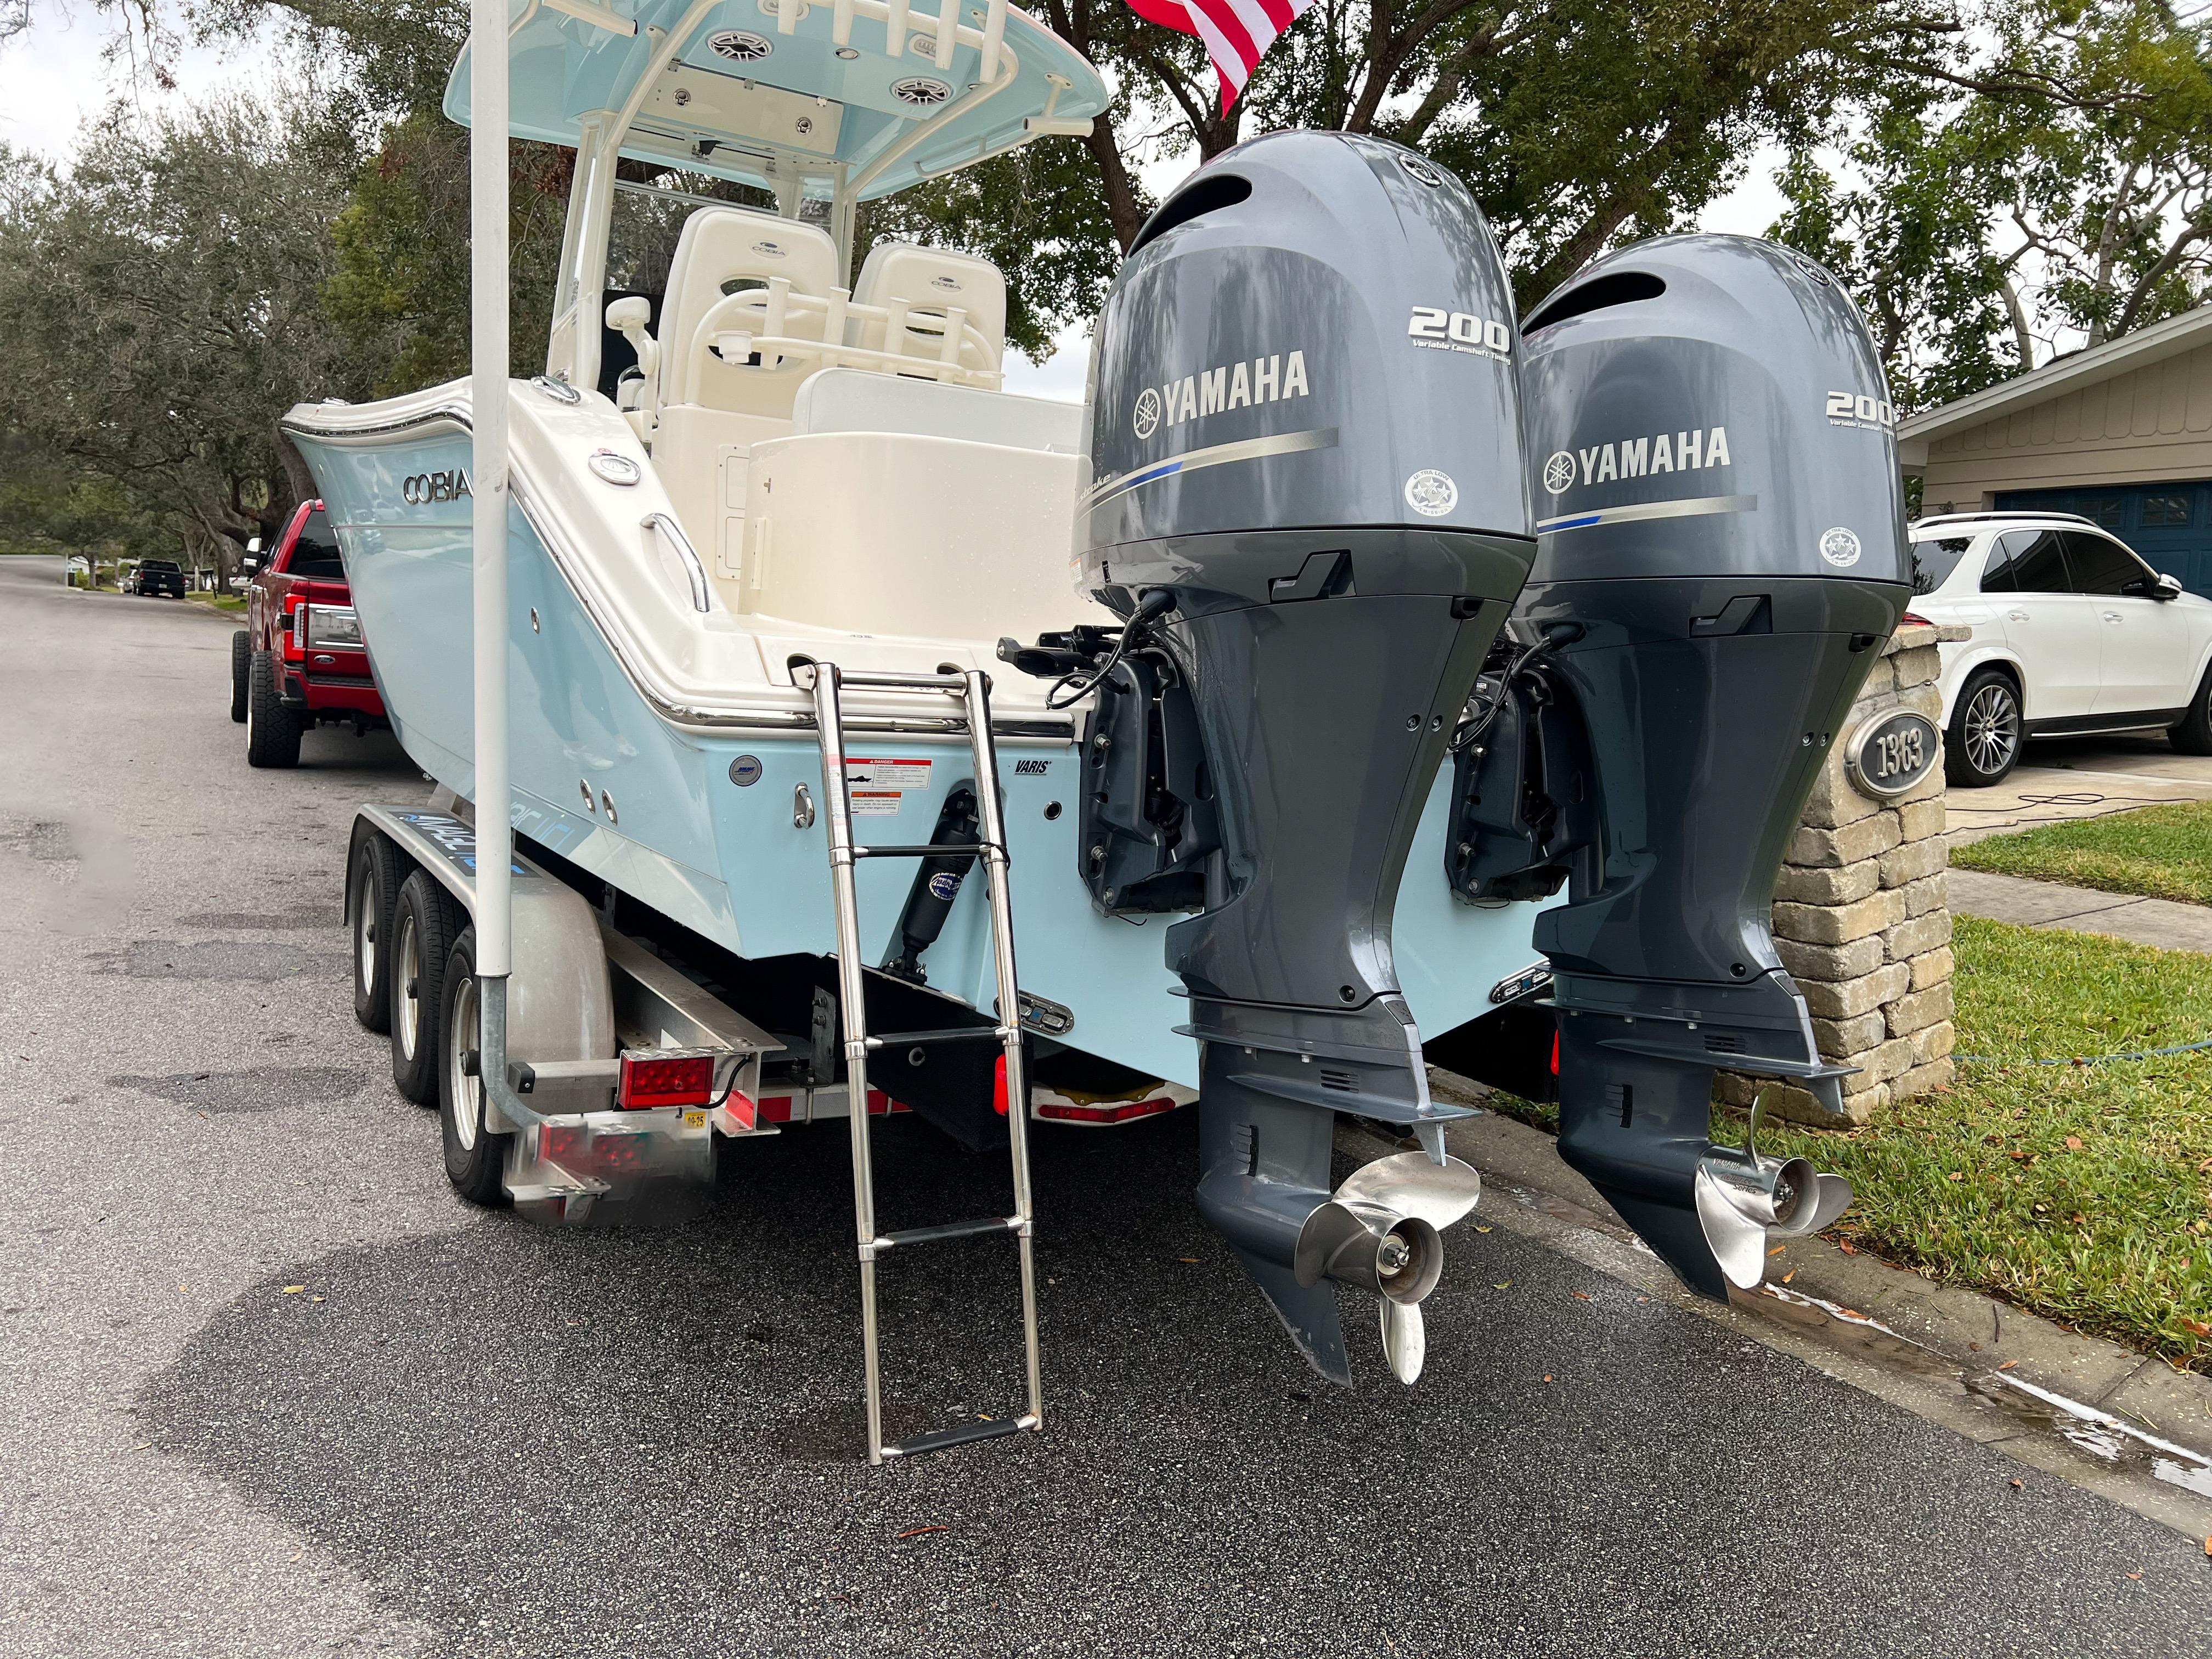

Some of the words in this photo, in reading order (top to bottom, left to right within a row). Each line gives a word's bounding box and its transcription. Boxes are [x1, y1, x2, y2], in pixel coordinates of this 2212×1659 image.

[752, 246, 786, 256] COBIA
[931, 281, 962, 290] COBIA
[1408, 306, 1510, 353] 200
[1412, 339, 1450, 350] Variable
[1452, 343, 1489, 357] Camshaft
[1491, 352, 1511, 365] Timing
[1163, 350, 1309, 427] YAMAHA
[1826, 391, 1893, 427] 200
[1830, 419, 1857, 427] Variable
[1578, 426, 1731, 486] YAMAHA
[1413, 470, 1434, 480] ULTRA
[1435, 471, 1449, 481] LOW
[403, 467, 474, 505] COBIA
[1876, 727, 1923, 778] 1363
[1015, 760, 1049, 774] VARIS
[1713, 1158, 1741, 1171] YAMAHA
[1733, 1184, 1758, 1194] Series
